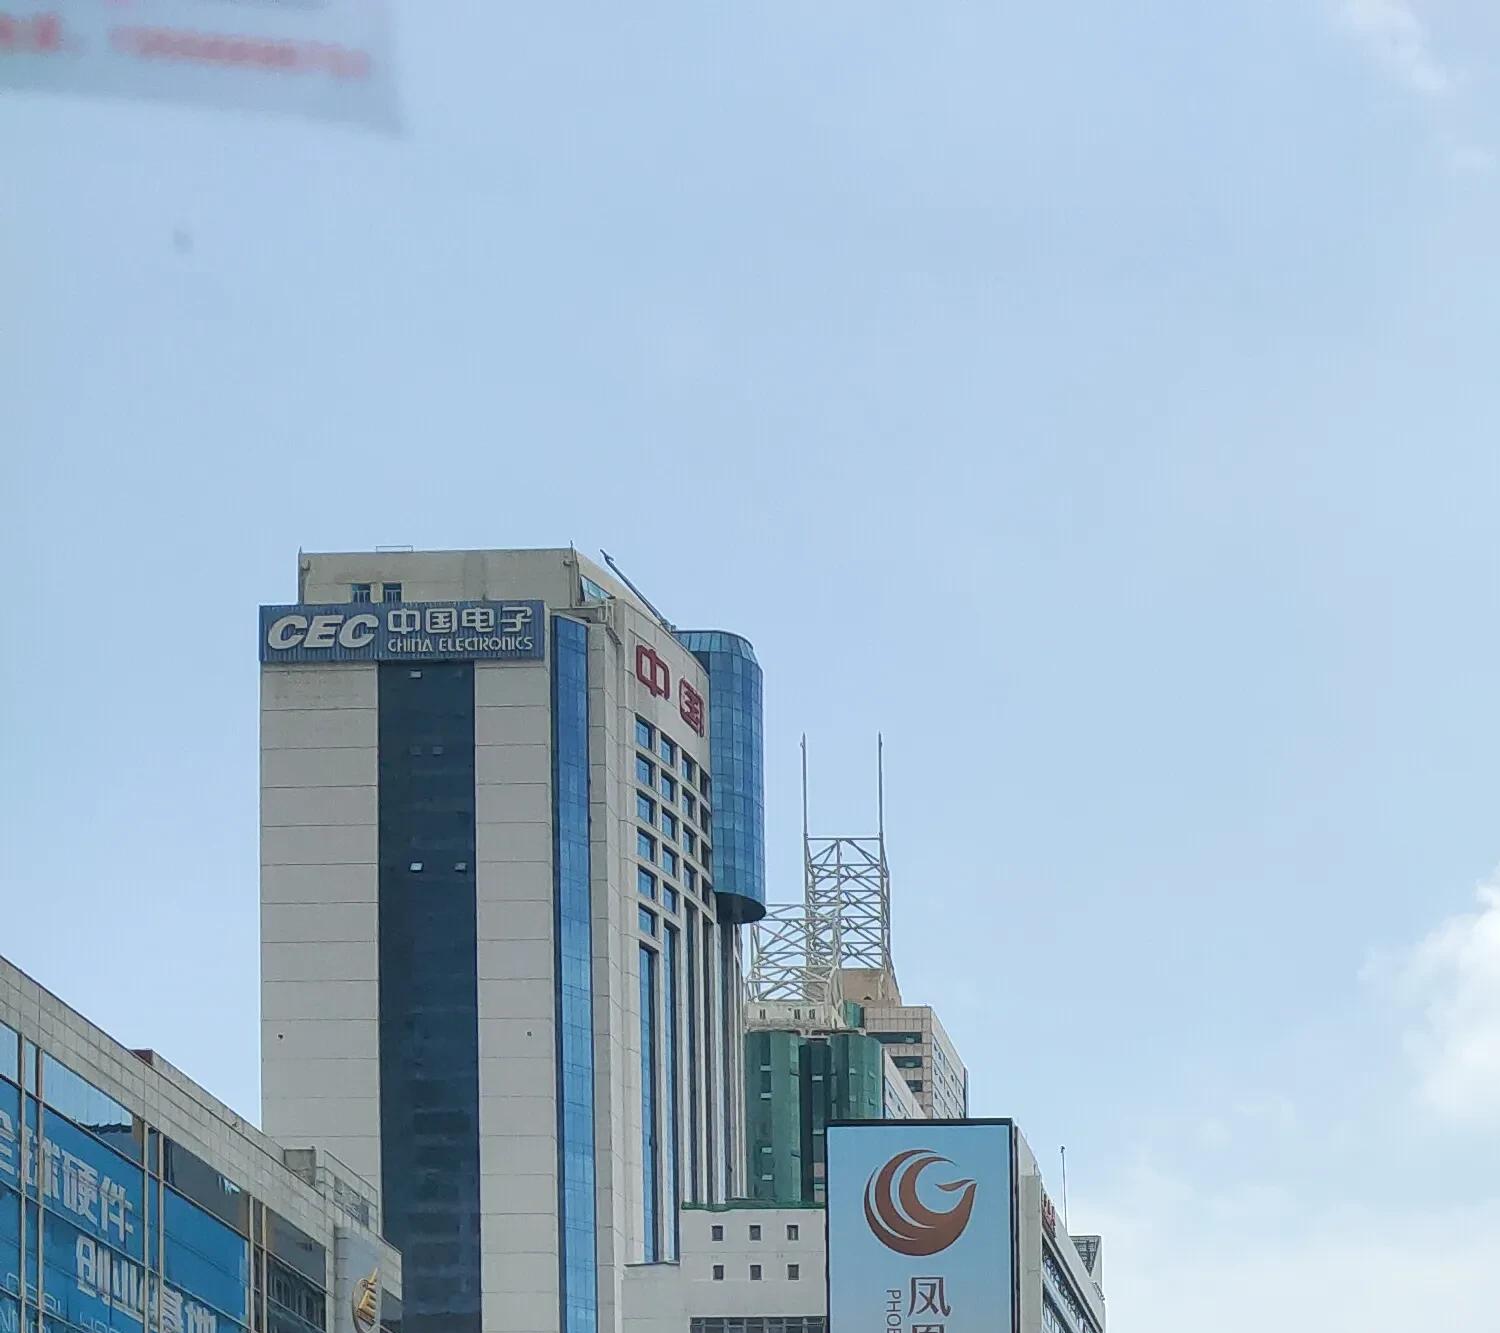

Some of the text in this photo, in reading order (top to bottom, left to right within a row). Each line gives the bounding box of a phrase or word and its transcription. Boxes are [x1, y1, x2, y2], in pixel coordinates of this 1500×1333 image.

[267, 613, 379, 650] CEC
[387, 607, 533, 634] 中国电子
[388, 636, 533, 652] CHINA ELECTRONICS
[635, 644, 705, 738] 中国
